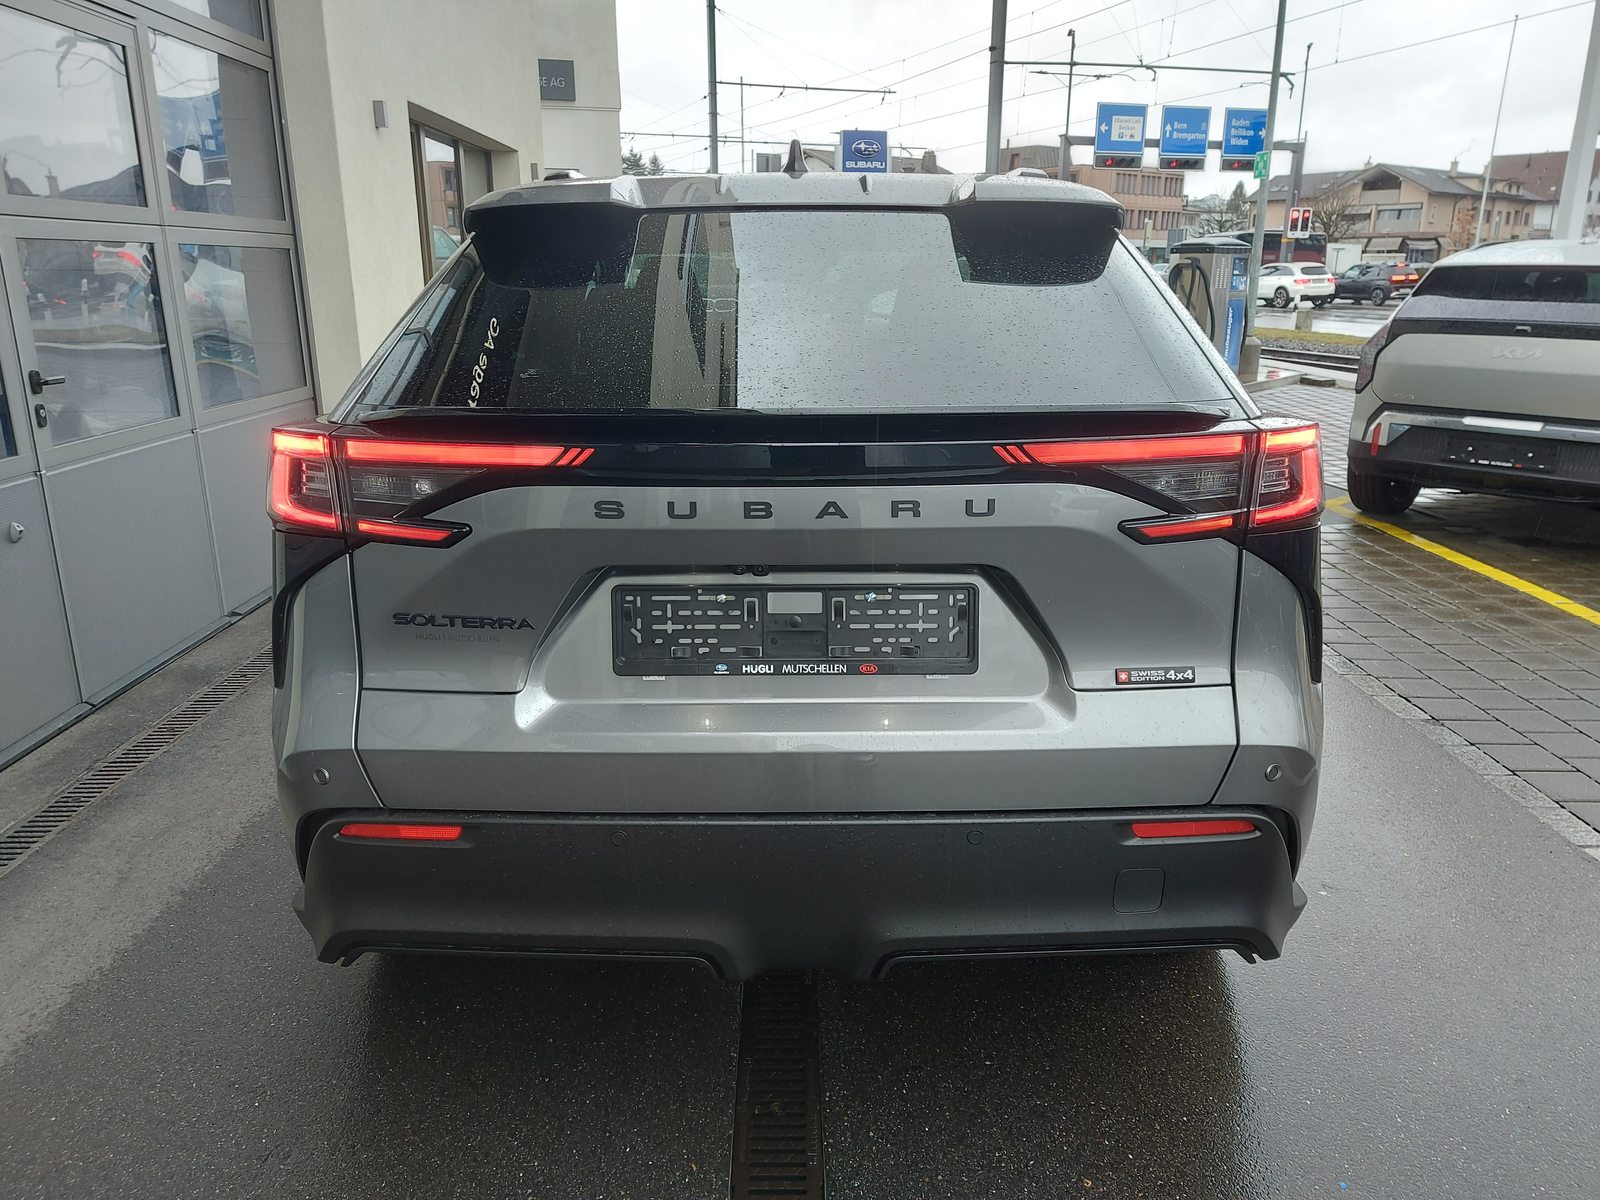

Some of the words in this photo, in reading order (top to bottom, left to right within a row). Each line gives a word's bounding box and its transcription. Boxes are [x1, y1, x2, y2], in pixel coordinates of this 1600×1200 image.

[550, 77, 565, 87] AG
[1173, 121, 1187, 130] Bern
[1232, 118, 1249, 127] Baden
[1172, 130, 1206, 142] Bremgarten
[1231, 128, 1254, 136] Bellikon
[1231, 137, 1248, 146] Widen
[845, 160, 886, 169] SUBARU
[594, 498, 997, 520] SUBARU
[392, 611, 536, 631] SOLTERRA
[782, 664, 847, 674] MUTSCHELLEN
[861, 665, 876, 673] KIA
[1165, 669, 1194, 681] 4x4
